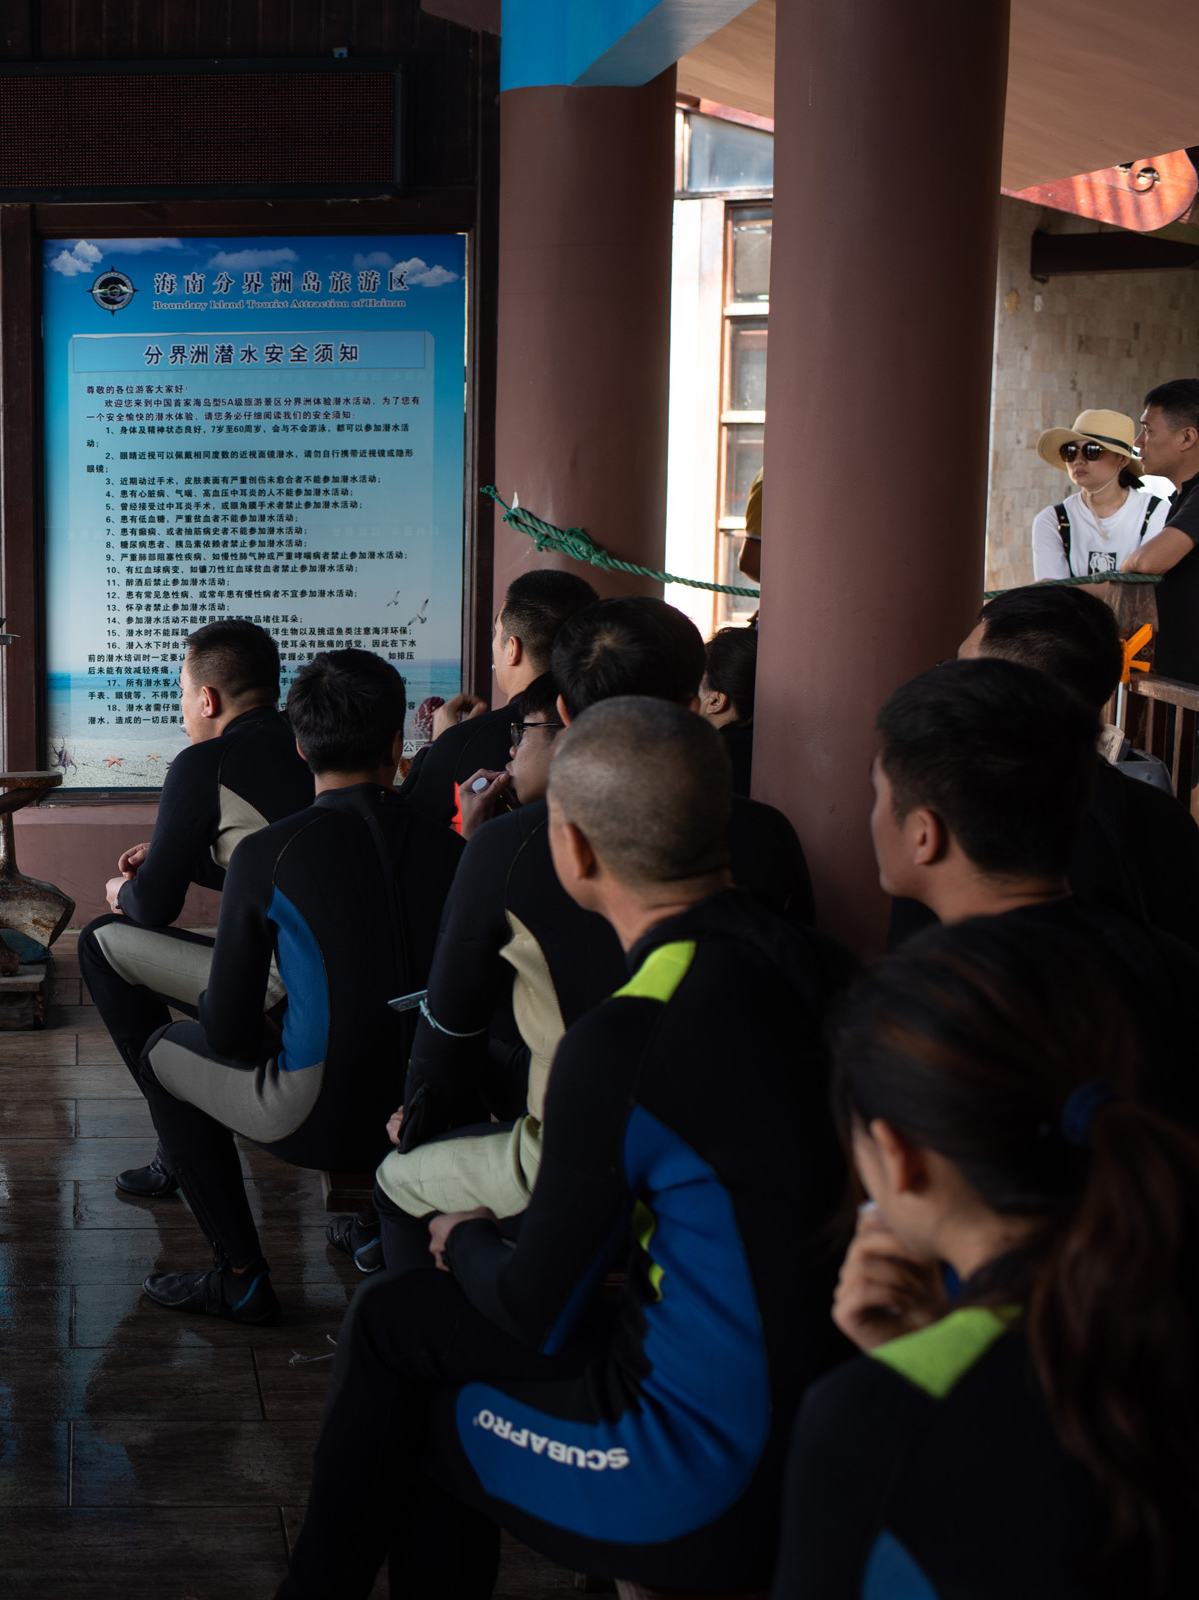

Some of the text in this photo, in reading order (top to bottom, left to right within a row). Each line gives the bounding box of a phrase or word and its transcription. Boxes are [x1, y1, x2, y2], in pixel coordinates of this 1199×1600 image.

[153, 270, 410, 295] 海南分界洲岛旅游区
[153, 298, 406, 312] Boundary Island Tourist Attraction of Hainan
[143, 342, 360, 366] 分界洲潜水安全须知
[276, 638, 417, 649] 使耳朵有胀痛的感觉，因此在下水
[478, 1408, 630, 1471] SCUBAPRO
